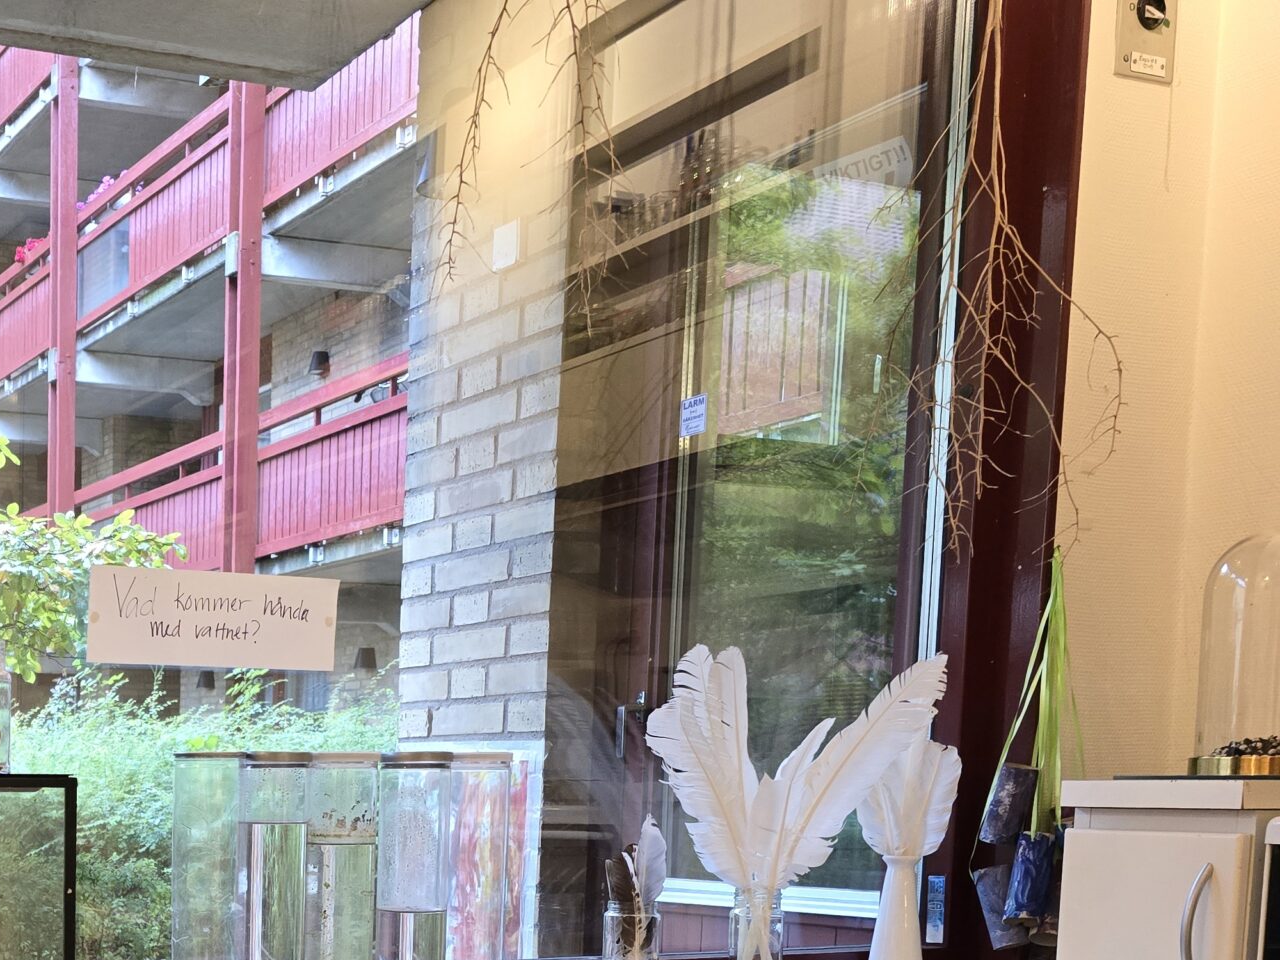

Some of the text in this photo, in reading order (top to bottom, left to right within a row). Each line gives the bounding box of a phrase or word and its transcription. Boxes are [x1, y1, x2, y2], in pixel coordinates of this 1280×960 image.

[683, 397, 705, 410] LARM
[113, 573, 157, 618] Vad
[174, 582, 252, 614] kommer
[194, 619, 261, 644] vattnet?
